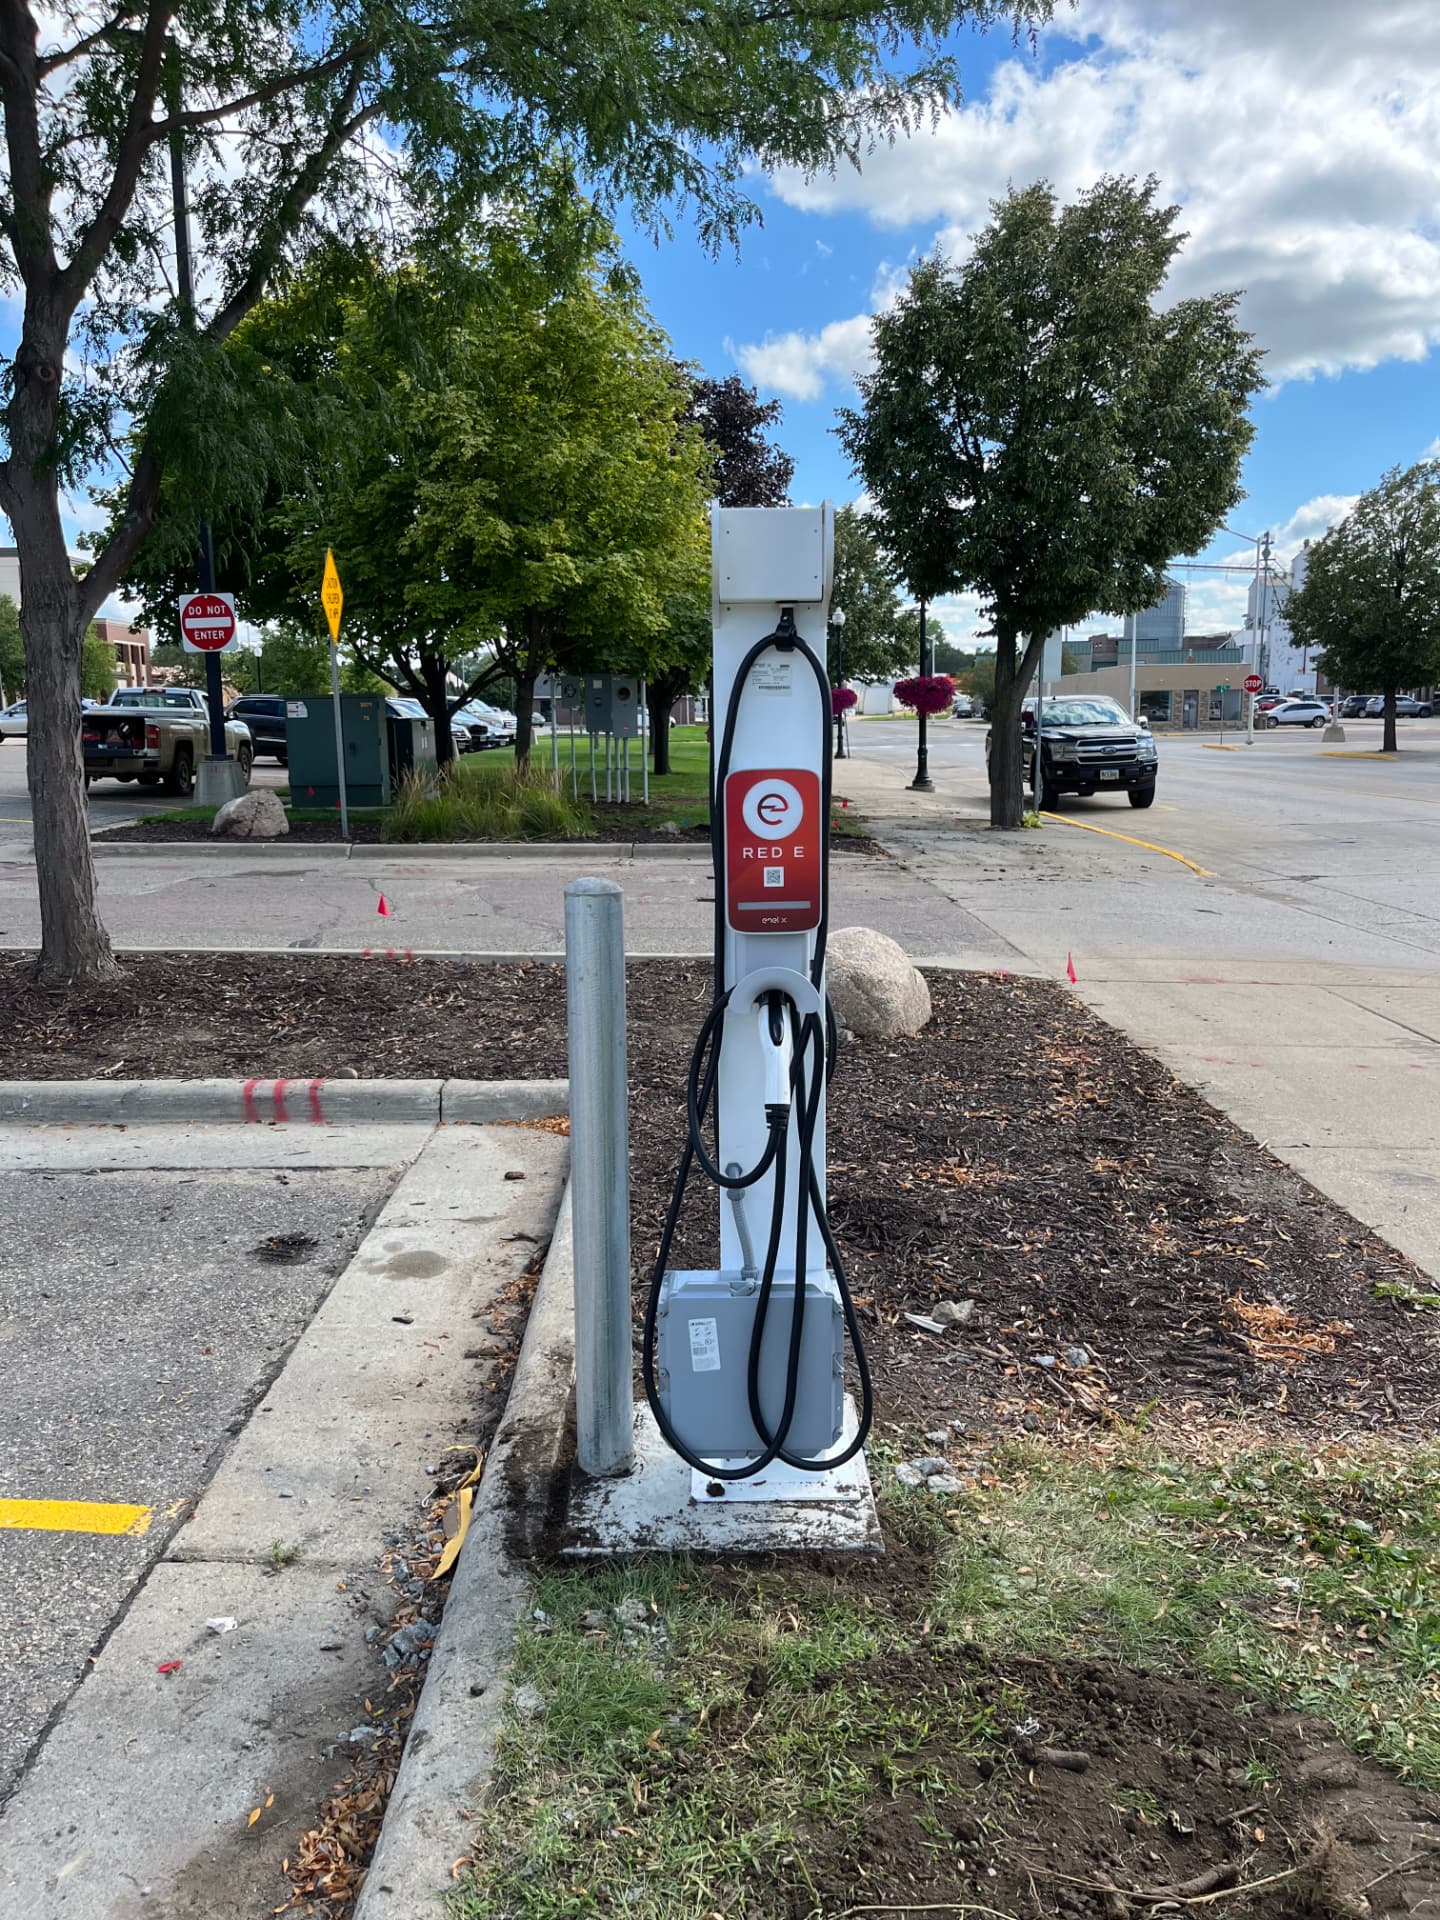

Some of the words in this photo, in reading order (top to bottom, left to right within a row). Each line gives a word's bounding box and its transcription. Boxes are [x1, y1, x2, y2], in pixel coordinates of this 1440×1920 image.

[188, 606, 202, 615] DO
[207, 605, 226, 615] NOT
[194, 630, 225, 640] ENTER
[1245, 679, 1262, 689] STOP
[742, 846, 783, 859] RED
[793, 846, 805, 858] E
[761, 916, 780, 924] enel
